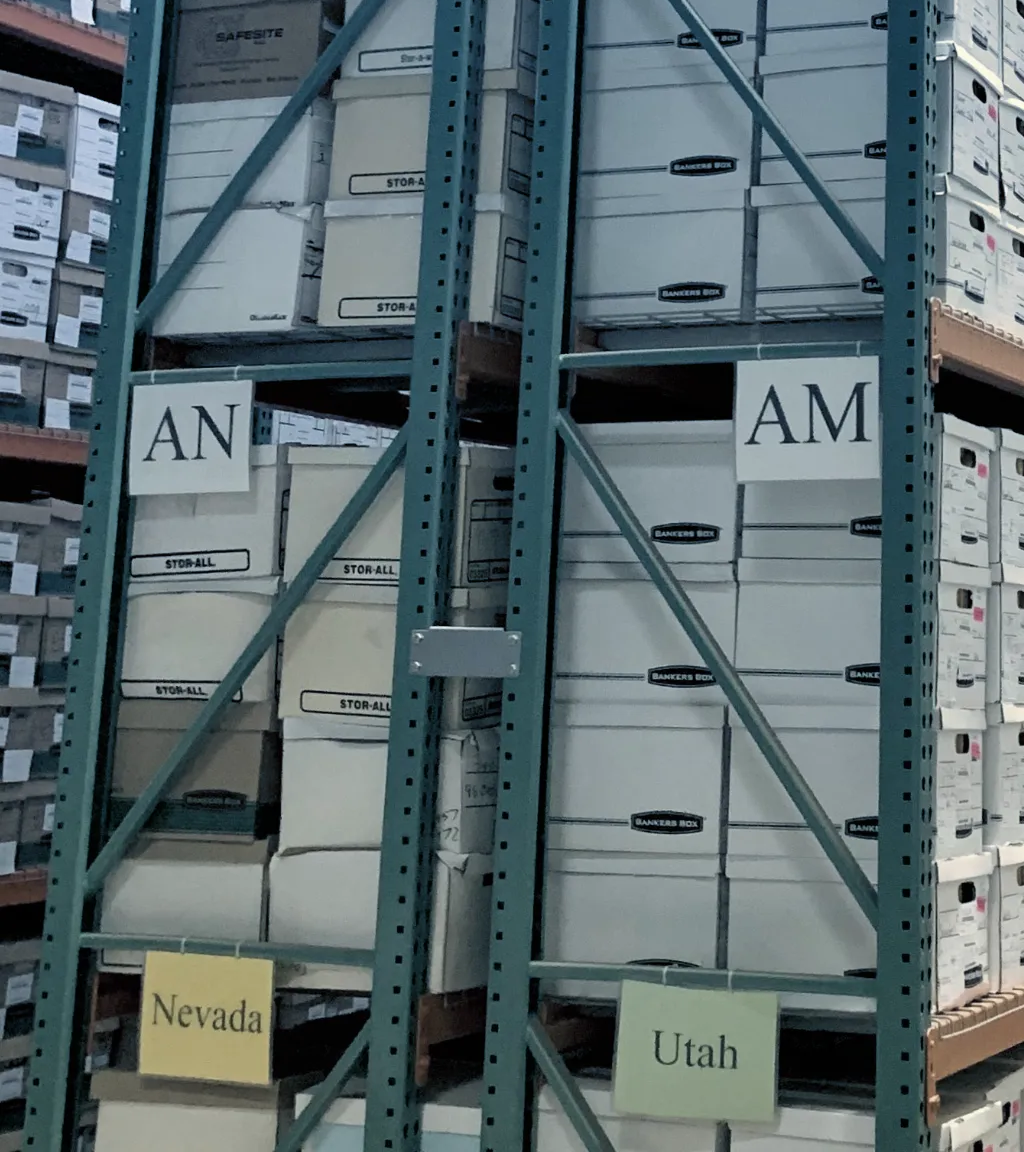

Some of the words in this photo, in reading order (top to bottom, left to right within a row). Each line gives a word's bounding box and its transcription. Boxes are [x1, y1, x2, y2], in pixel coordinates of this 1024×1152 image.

[215, 28, 284, 43] SAFESITE
[673, 162, 712, 171] BANKERS
[713, 160, 732, 169] BOX
[386, 177, 425, 189] STOR-A
[662, 289, 701, 297] BANKERS
[702, 288, 721, 296] BOX
[377, 302, 416, 313] STOR-A
[744, 381, 873, 446] AM
[142, 403, 241, 462] AN
[654, 530, 695, 538] BANKERS
[697, 529, 716, 538] BOX
[651, 672, 694, 681] BANKERS
[695, 673, 715, 682] BOX
[849, 671, 880, 679] BANKE
[635, 818, 678, 828] BANKERS
[679, 819, 699, 828] BOX
[151, 992, 263, 1035] Nevada
[653, 1029, 738, 1070] Utah
